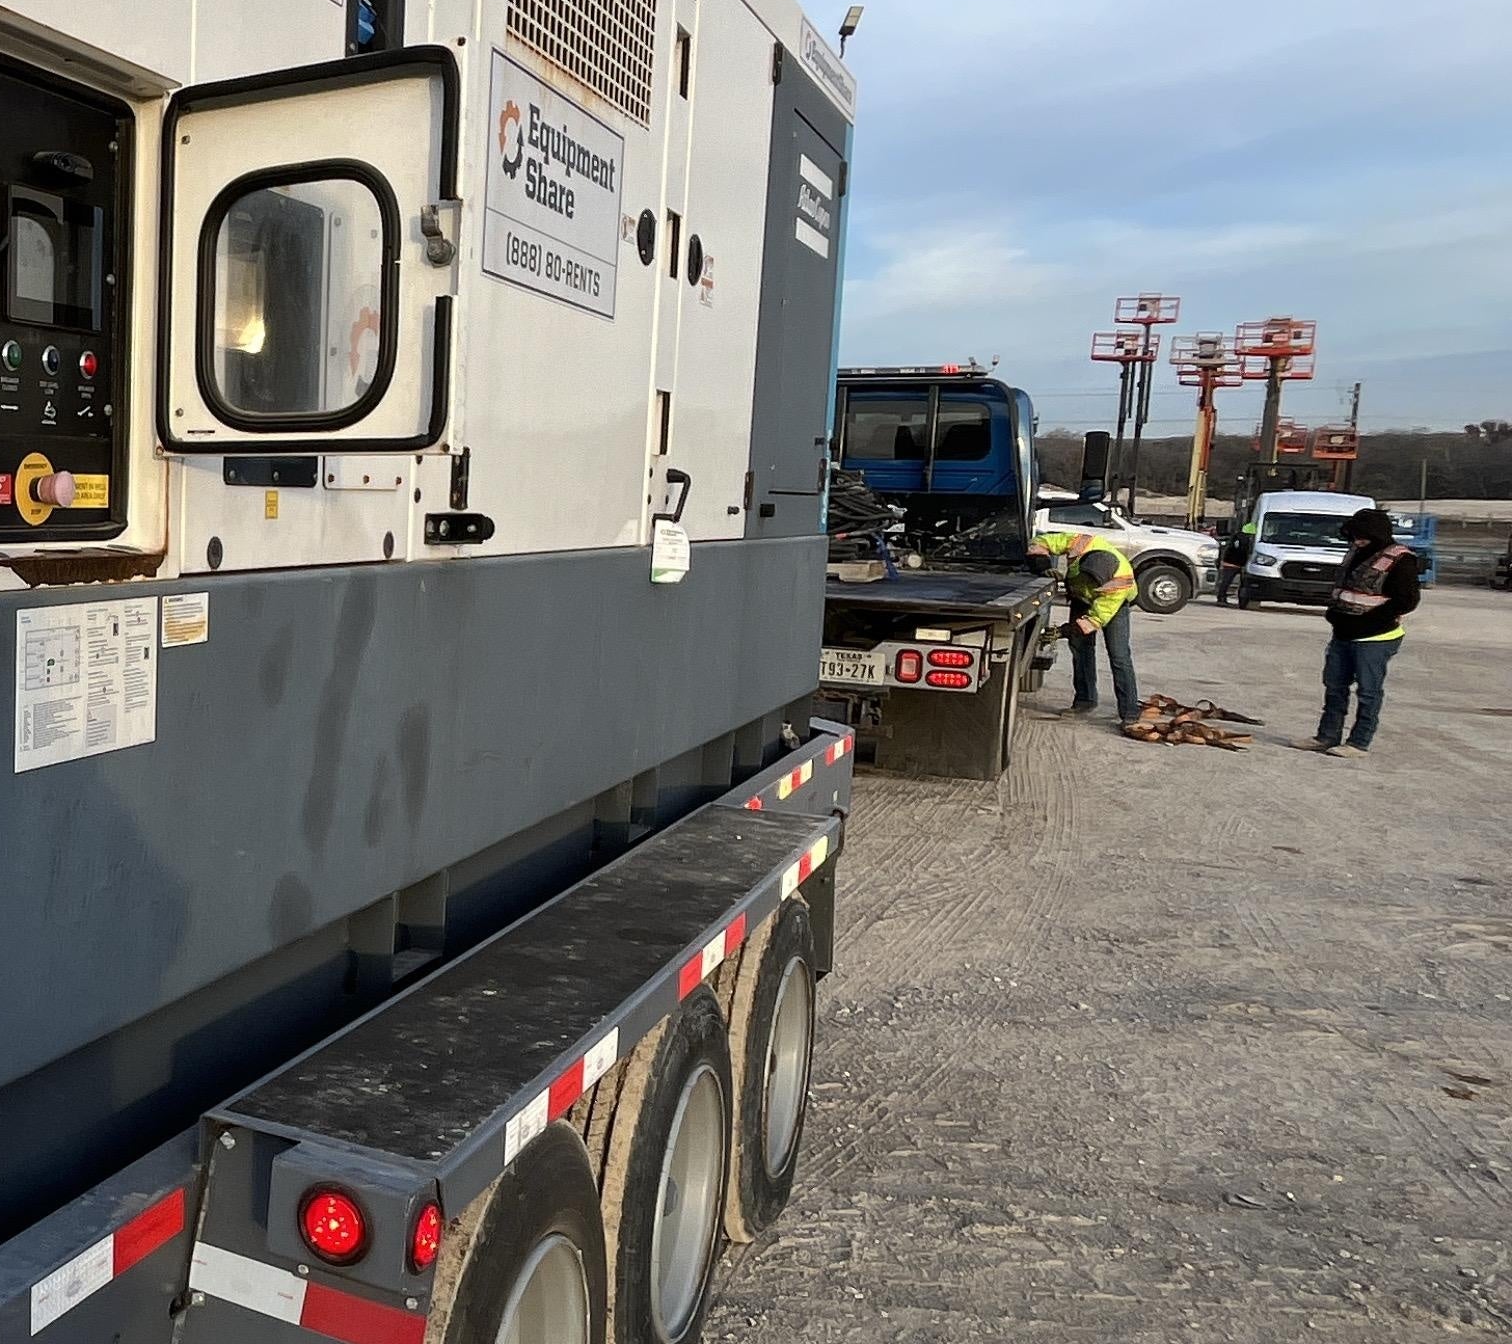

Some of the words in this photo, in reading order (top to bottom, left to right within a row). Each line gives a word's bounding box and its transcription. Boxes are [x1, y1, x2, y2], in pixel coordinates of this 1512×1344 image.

[528, 102, 616, 194] Equipment
[525, 156, 575, 219] Share
[506, 231, 542, 277] (888)
[545, 251, 601, 297] 80-RENTS
